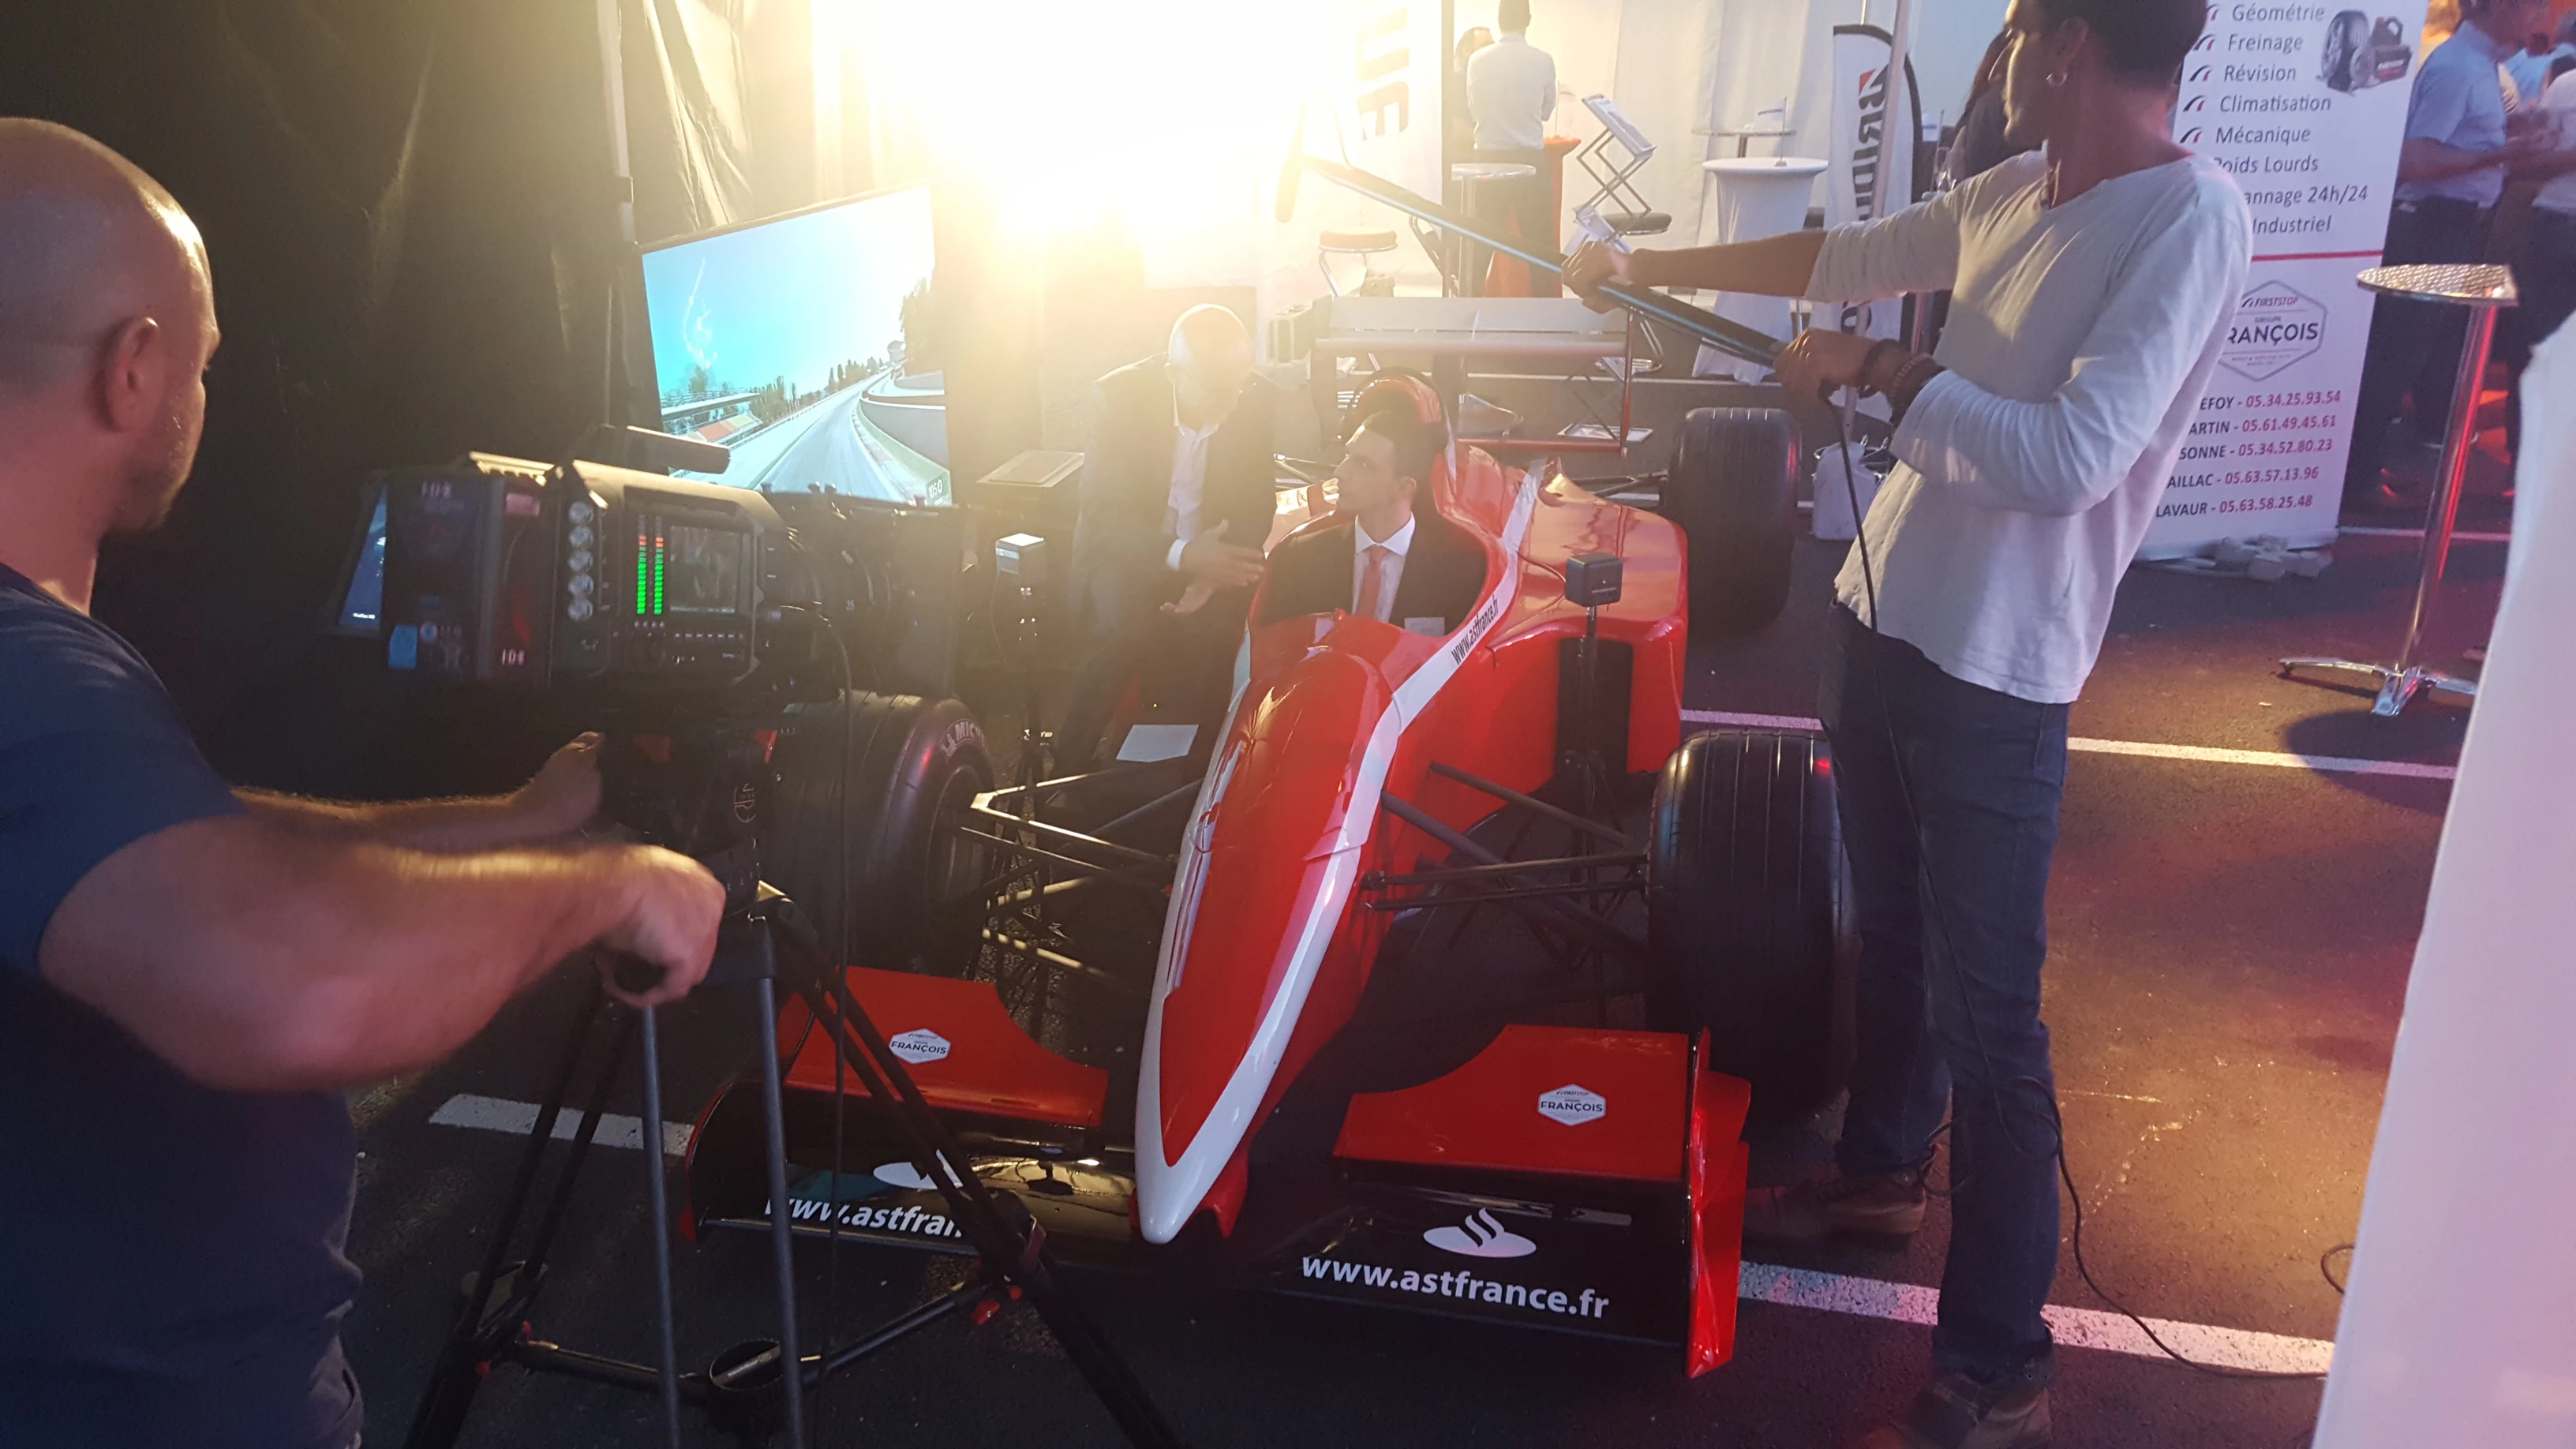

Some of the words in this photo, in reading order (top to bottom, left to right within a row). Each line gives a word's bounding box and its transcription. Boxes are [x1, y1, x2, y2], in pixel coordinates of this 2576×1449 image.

[2232, 2, 2325, 22] Géométrie
[2227, 33, 2304, 54] Freinage
[2223, 63, 2297, 82] Révision
[2220, 94, 2332, 113] Climatisation
[2215, 125, 2311, 146] Mécanique
[2263, 152, 2320, 173] Lourds
[2308, 184, 2368, 206] 24h/24
[2252, 214, 2332, 234] Industriel
[2245, 390, 2342, 408] 05.34.25.93.54
[2241, 414, 2336, 433] 05.61.49.45.61
[2238, 438, 2333, 457] 05.34.52.80.23
[2225, 466, 2320, 485] 05.63.57.13.96
[2155, 501, 2208, 518] LAVAUR
[2218, 494, 2313, 513] 05.63.58.25.48
[1451, 593, 1500, 665] www.astfrance.fr
[890, 1040, 947, 1054] FRANÇOIS
[1540, 1101, 1603, 1112] FRANÇOIS
[1302, 1256, 1610, 1319] www.astfrance.fr
